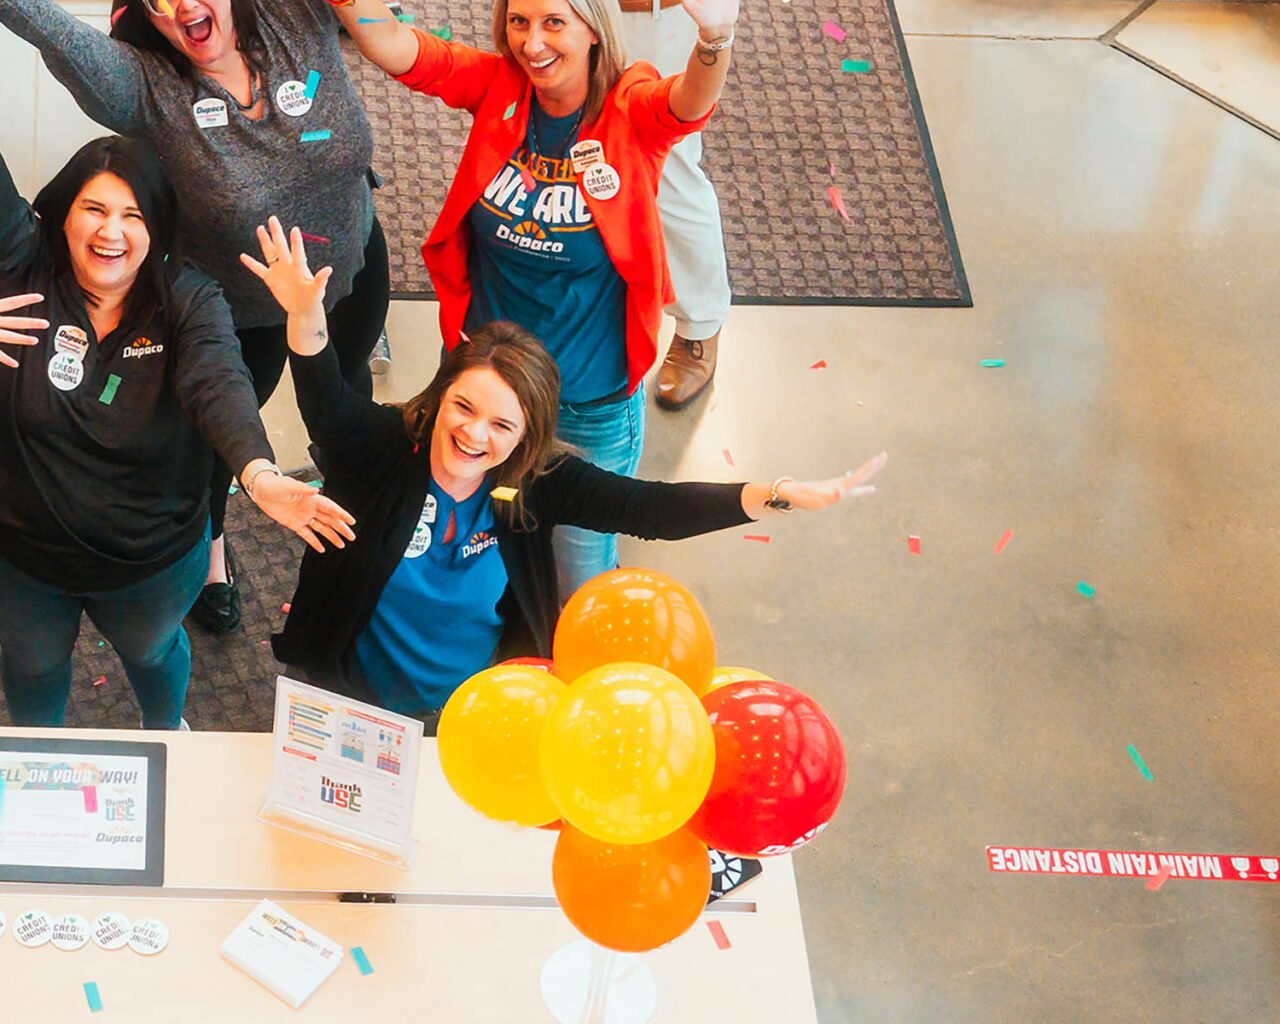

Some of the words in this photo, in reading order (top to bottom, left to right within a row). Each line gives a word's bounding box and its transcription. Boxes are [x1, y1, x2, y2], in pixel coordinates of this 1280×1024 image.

[280, 89, 306, 104] CREDI
[196, 105, 225, 114] Dupaco
[282, 98, 310, 111] UNIONS
[573, 146, 600, 159] Dupaco
[586, 174, 613, 186] CREDIT
[588, 182, 616, 194] UNIONS
[496, 224, 564, 253] Dupaco
[58, 330, 88, 346] Dupaco
[122, 344, 164, 359] Dupaco
[52, 361, 80, 376] CREDIT
[51, 370, 78, 385] UNIONS
[28, 768, 50, 784] ON
[52, 768, 92, 785] YOUR
[99, 770, 138, 785] WAY!
[320, 774, 362, 794] Thank
[320, 786, 363, 813] USE
[95, 832, 144, 845] Dupaco
[989, 848, 1104, 874] DISTANCE
[1107, 852, 1223, 878] MAINTAIN
[16, 916, 46, 935] CREDIT
[52, 932, 84, 942] UNIONS
